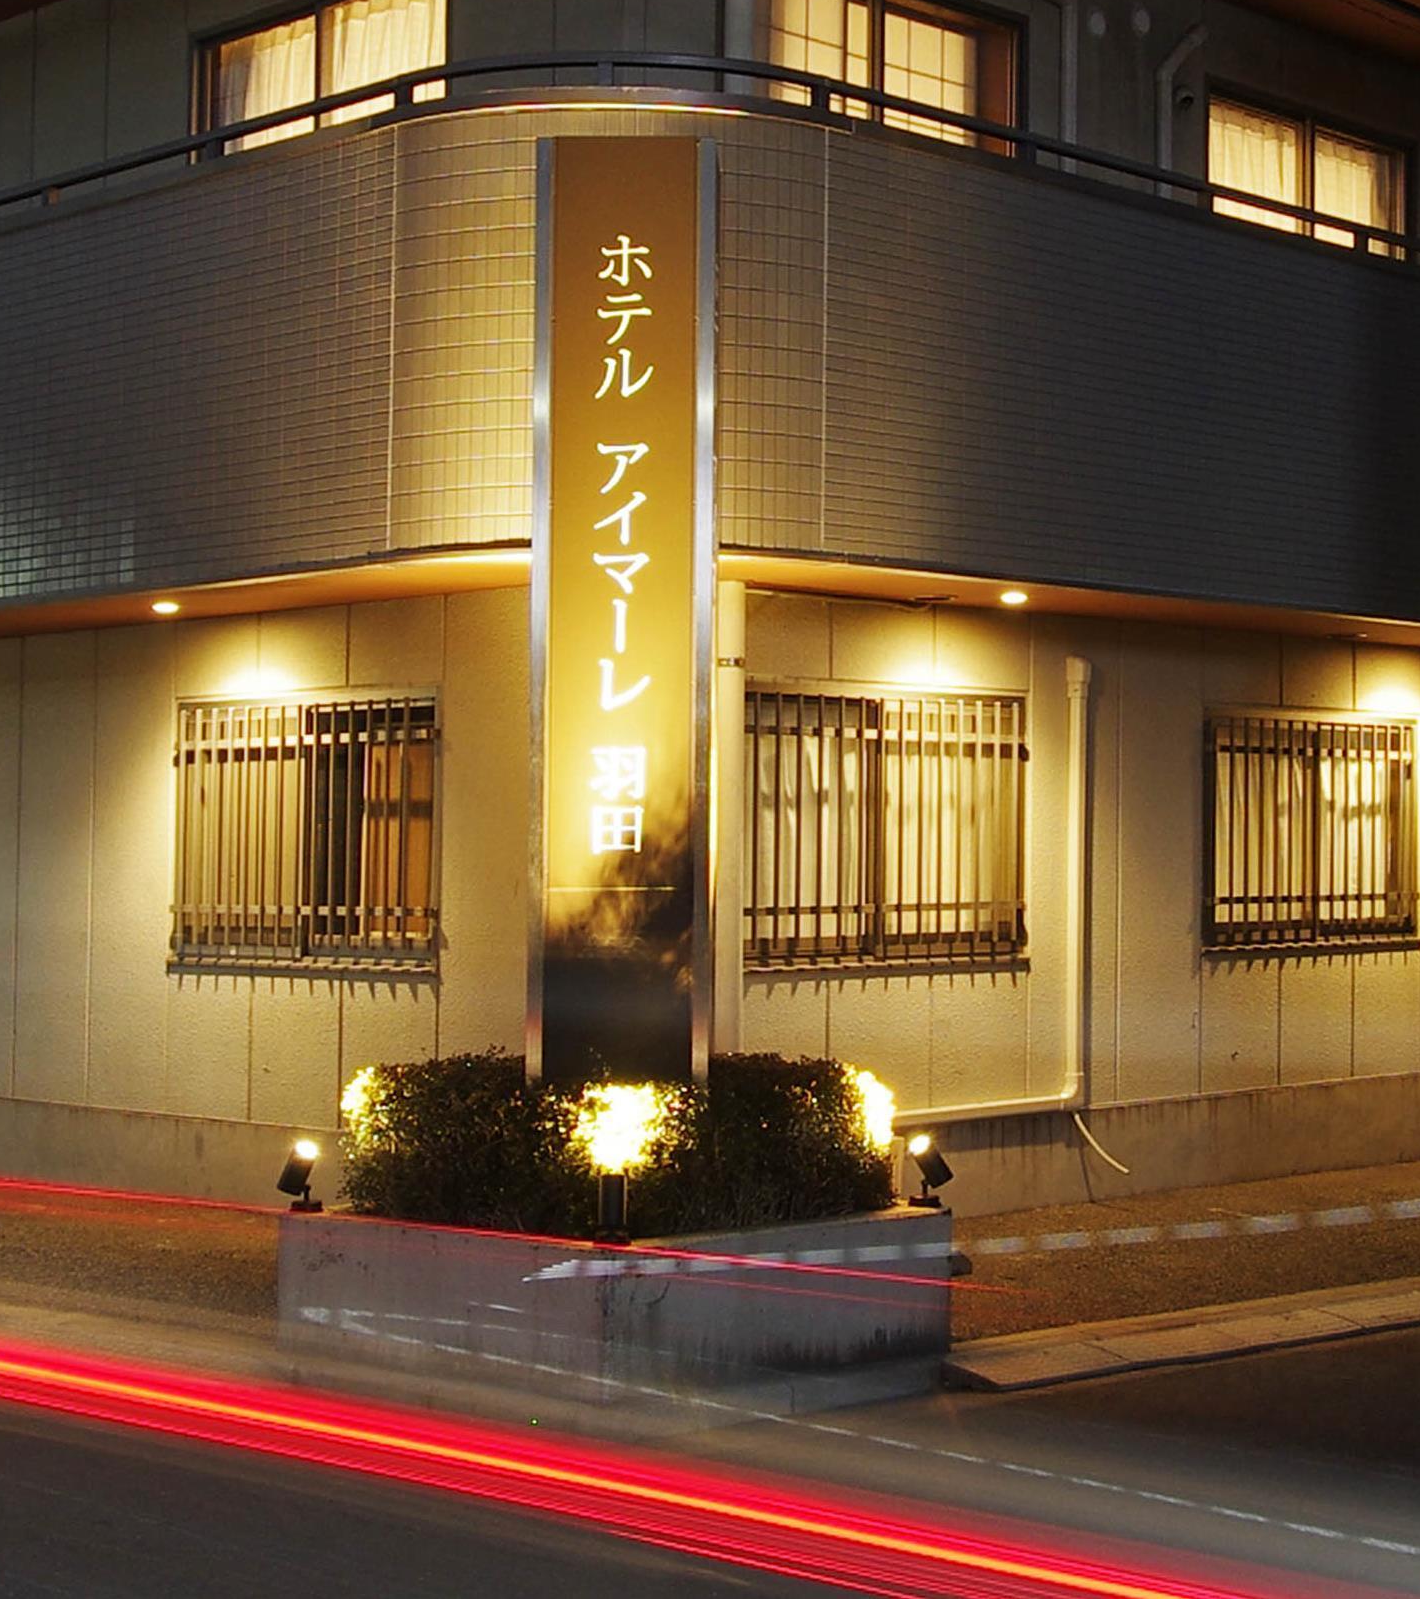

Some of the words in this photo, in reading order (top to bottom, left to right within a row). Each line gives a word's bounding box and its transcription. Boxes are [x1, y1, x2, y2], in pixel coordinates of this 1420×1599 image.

[594, 234, 654, 400] ホテル
[593, 442, 651, 712] アイマーレ
[590, 745, 647, 854] 羽田
